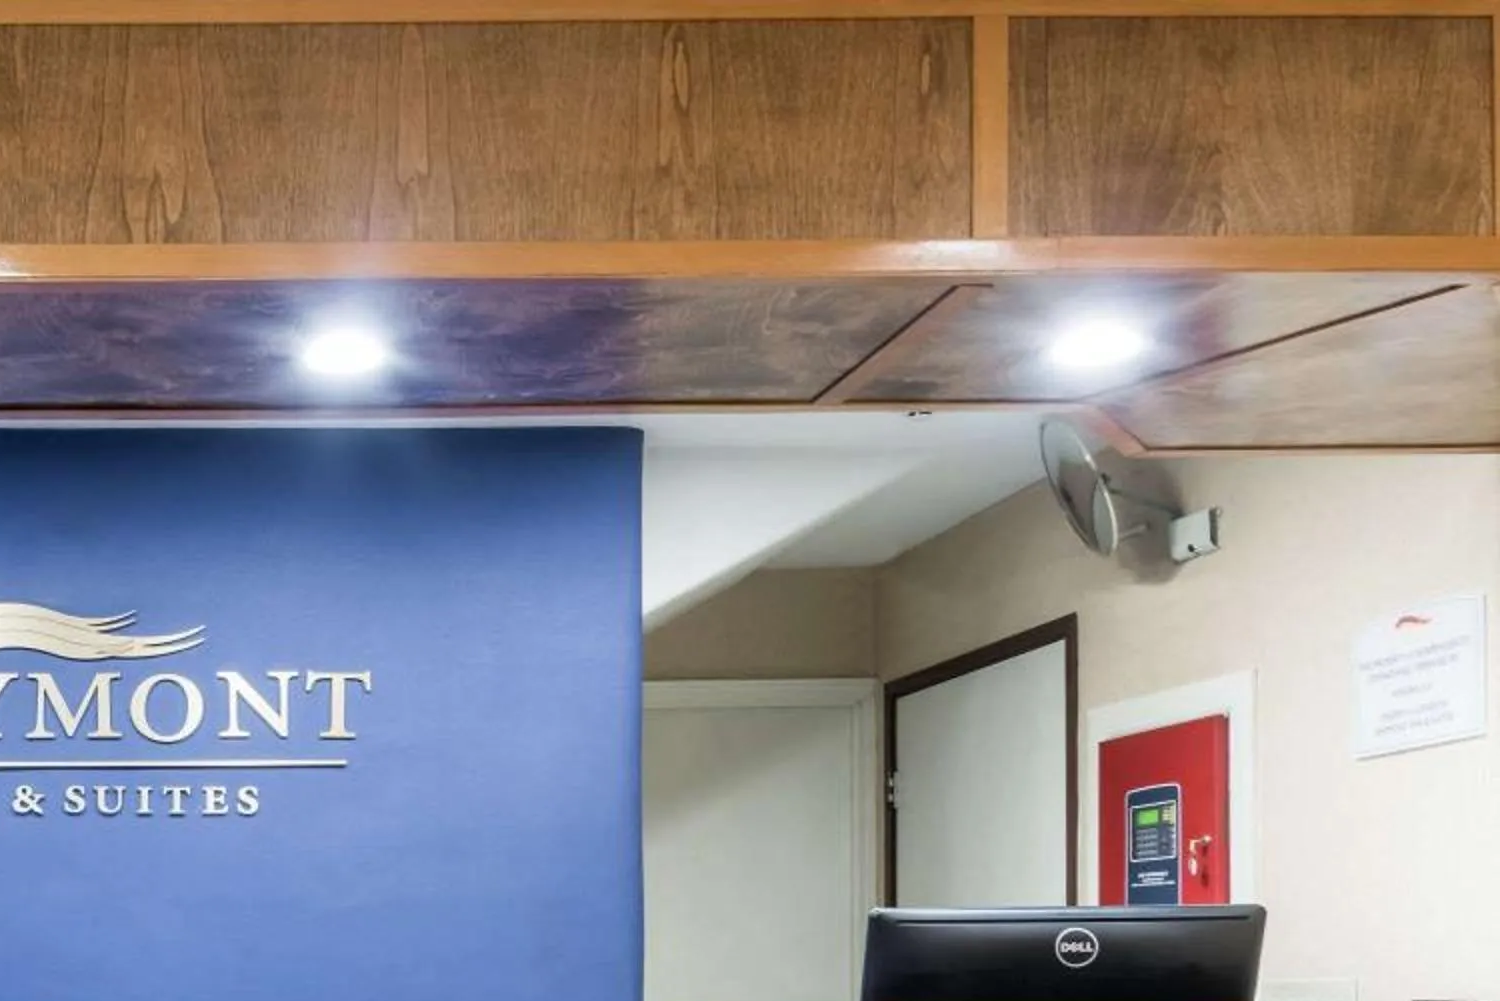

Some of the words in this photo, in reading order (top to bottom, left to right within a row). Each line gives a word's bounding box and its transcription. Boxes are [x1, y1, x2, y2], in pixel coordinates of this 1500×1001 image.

[12, 784, 45, 815] &
[63, 785, 261, 816] SUITES
[1061, 941, 1094, 953] DELL
